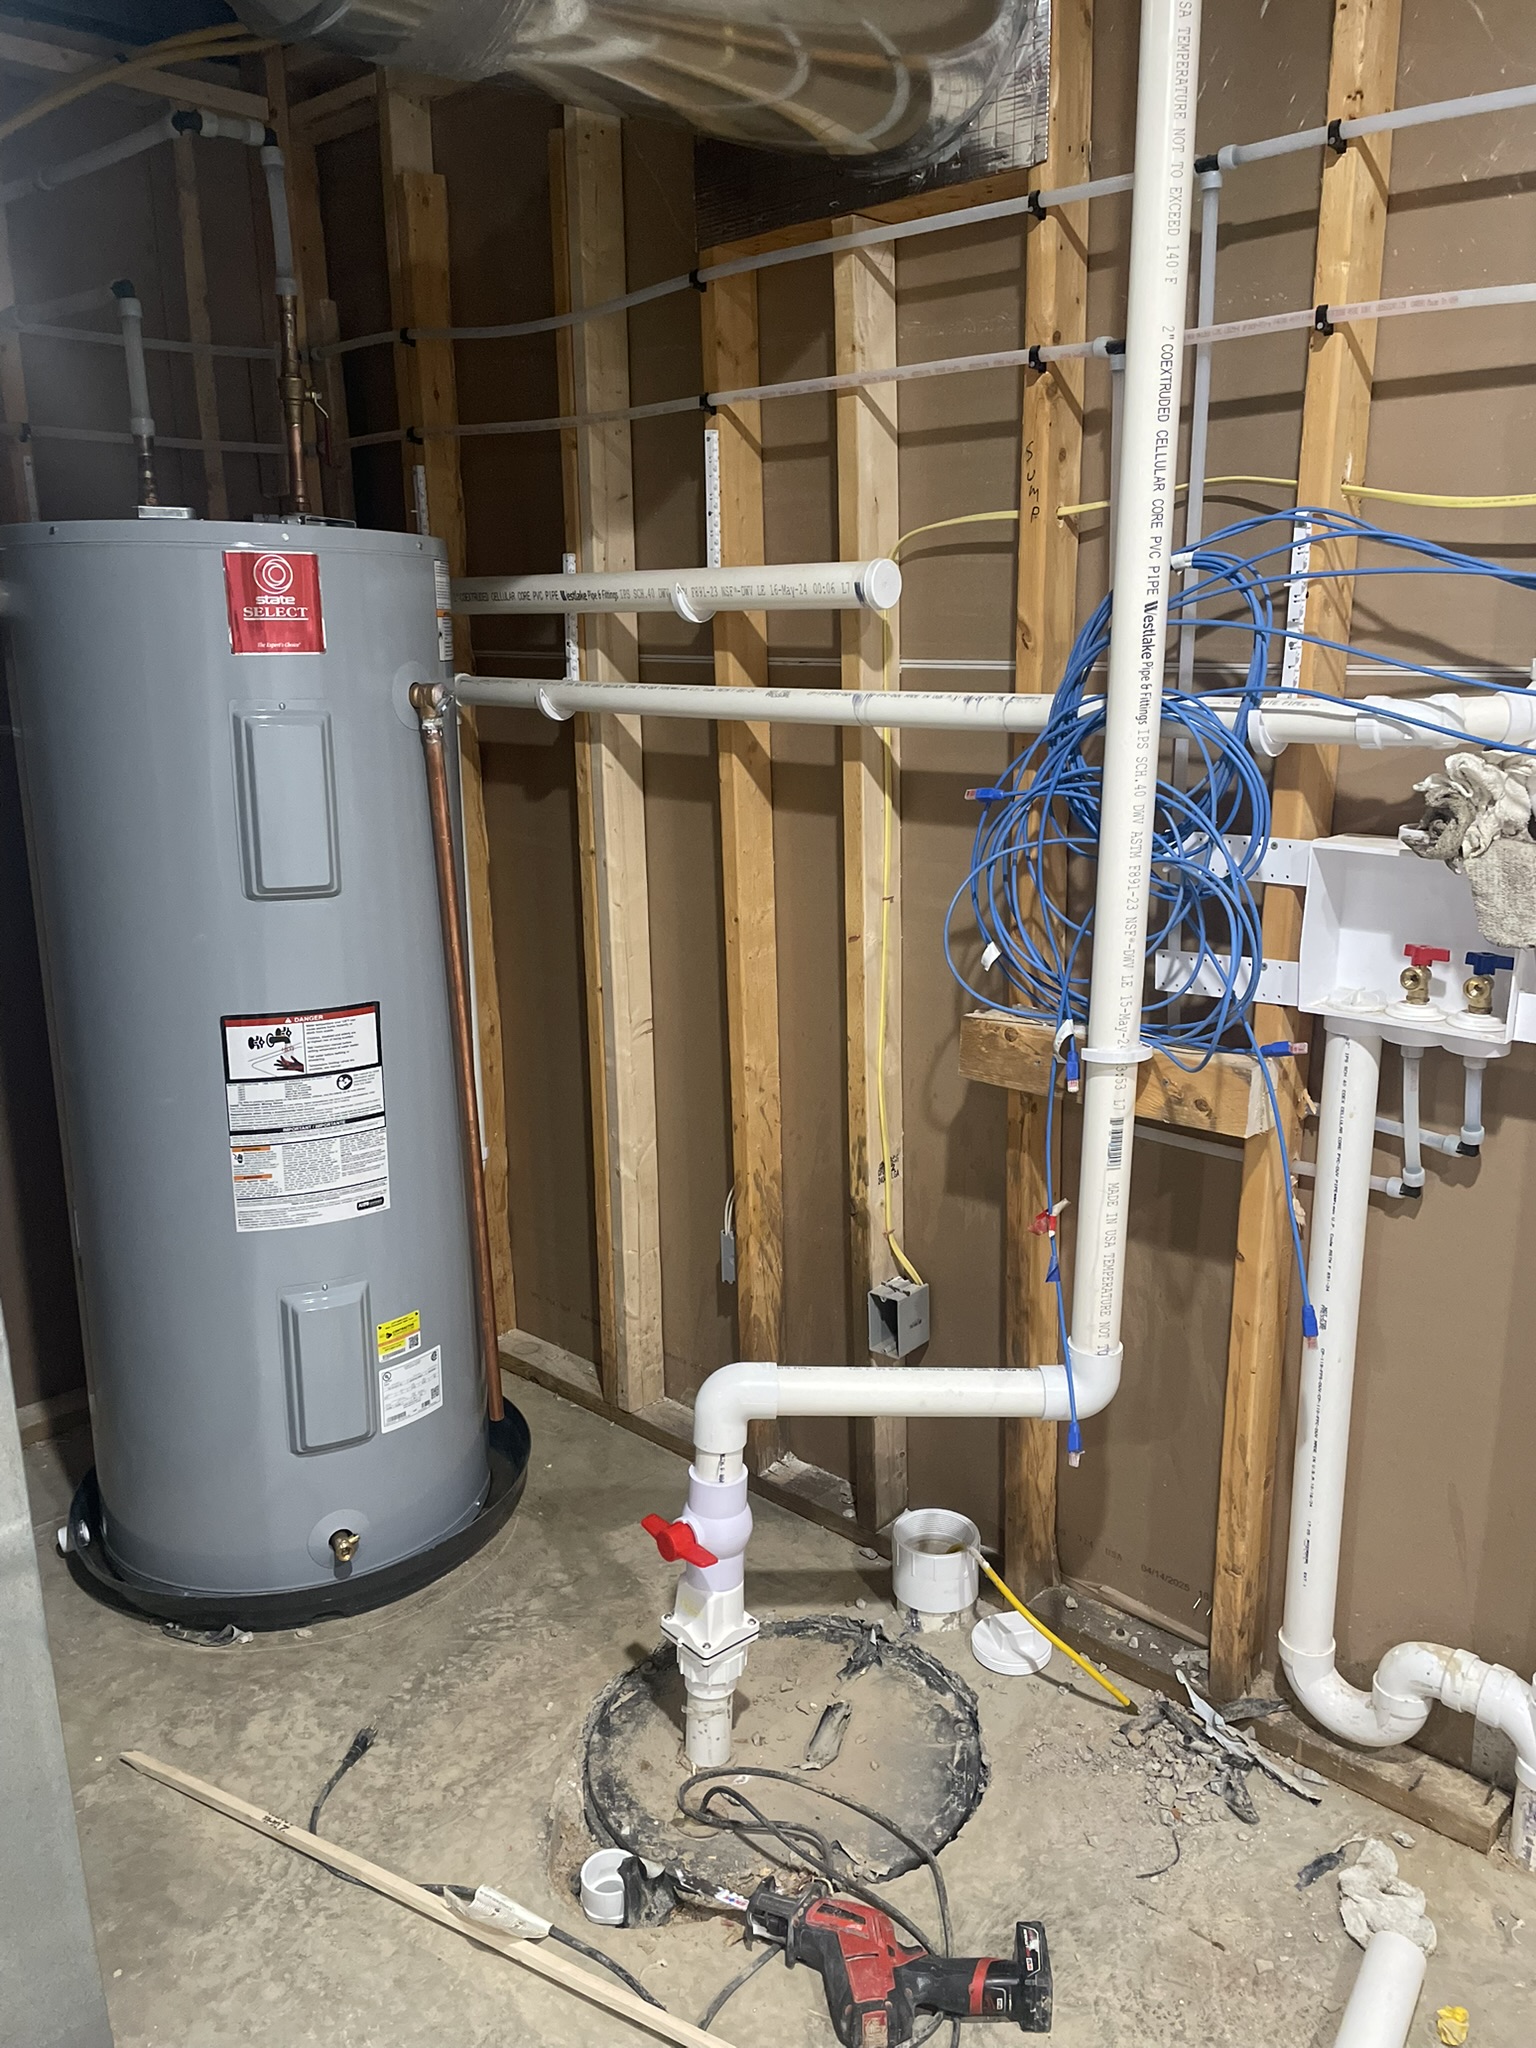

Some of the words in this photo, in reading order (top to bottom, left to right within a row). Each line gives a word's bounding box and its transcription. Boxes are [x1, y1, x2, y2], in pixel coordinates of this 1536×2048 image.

[1174, 26, 1191, 120] TEMPERATURE
[1172, 127, 1186, 153] NOT
[1170, 161, 1184, 179] TO
[1168, 187, 1182, 236] EXCEED
[1162, 325, 1176, 340] 2"
[1157, 343, 1174, 422] COEXTRUDED
[1153, 430, 1168, 492] CELLULAR
[1026, 440, 1040, 523] SUMP
[1150, 498, 1164, 529] CORE
[1148, 536, 1162, 559] PVC
[757, 584, 765, 596] LE
[770, 584, 807, 598] 16-May-24
[813, 582, 836, 594] 00:06
[841, 582, 850, 594] L7
[1146, 566, 1160, 596] PIPE
[255, 595, 296, 605] state
[491, 591, 516, 602] CELLULAR
[517, 590, 532, 601] CORE
[532, 590, 543, 601] PVC
[545, 590, 559, 600] PIPE
[560, 590, 588, 602] Westlake
[620, 589, 630, 600] IPS
[243, 606, 308, 618] SELECT
[1140, 600, 1158, 660] Westlake
[1138, 661, 1154, 682] Pipe
[1140, 682, 1152, 690] &
[1135, 692, 1152, 726] Fittings
[1136, 729, 1150, 750] IPS
[1134, 756, 1148, 798] SCH.40
[1132, 804, 1145, 825] DWV
[1130, 831, 1143, 860] ASTM
[1126, 865, 1141, 911] F891-23
[1120, 975, 1134, 988] LE
[294, 1014, 324, 1023] DANGER
[1114, 995, 1134, 1049] 15-May-2
[1114, 1062, 1128, 1091] 3:53
[1113, 1099, 1126, 1110] L7
[1106, 1182, 1119, 1208] MADE
[1106, 1213, 1118, 1225] IN
[1104, 1230, 1117, 1248] USA
[1100, 1253, 1116, 1317] TEMPERATURE
[1098, 1321, 1110, 1338] NOT
[1140, 1564, 1190, 1592] 04/14/2025
